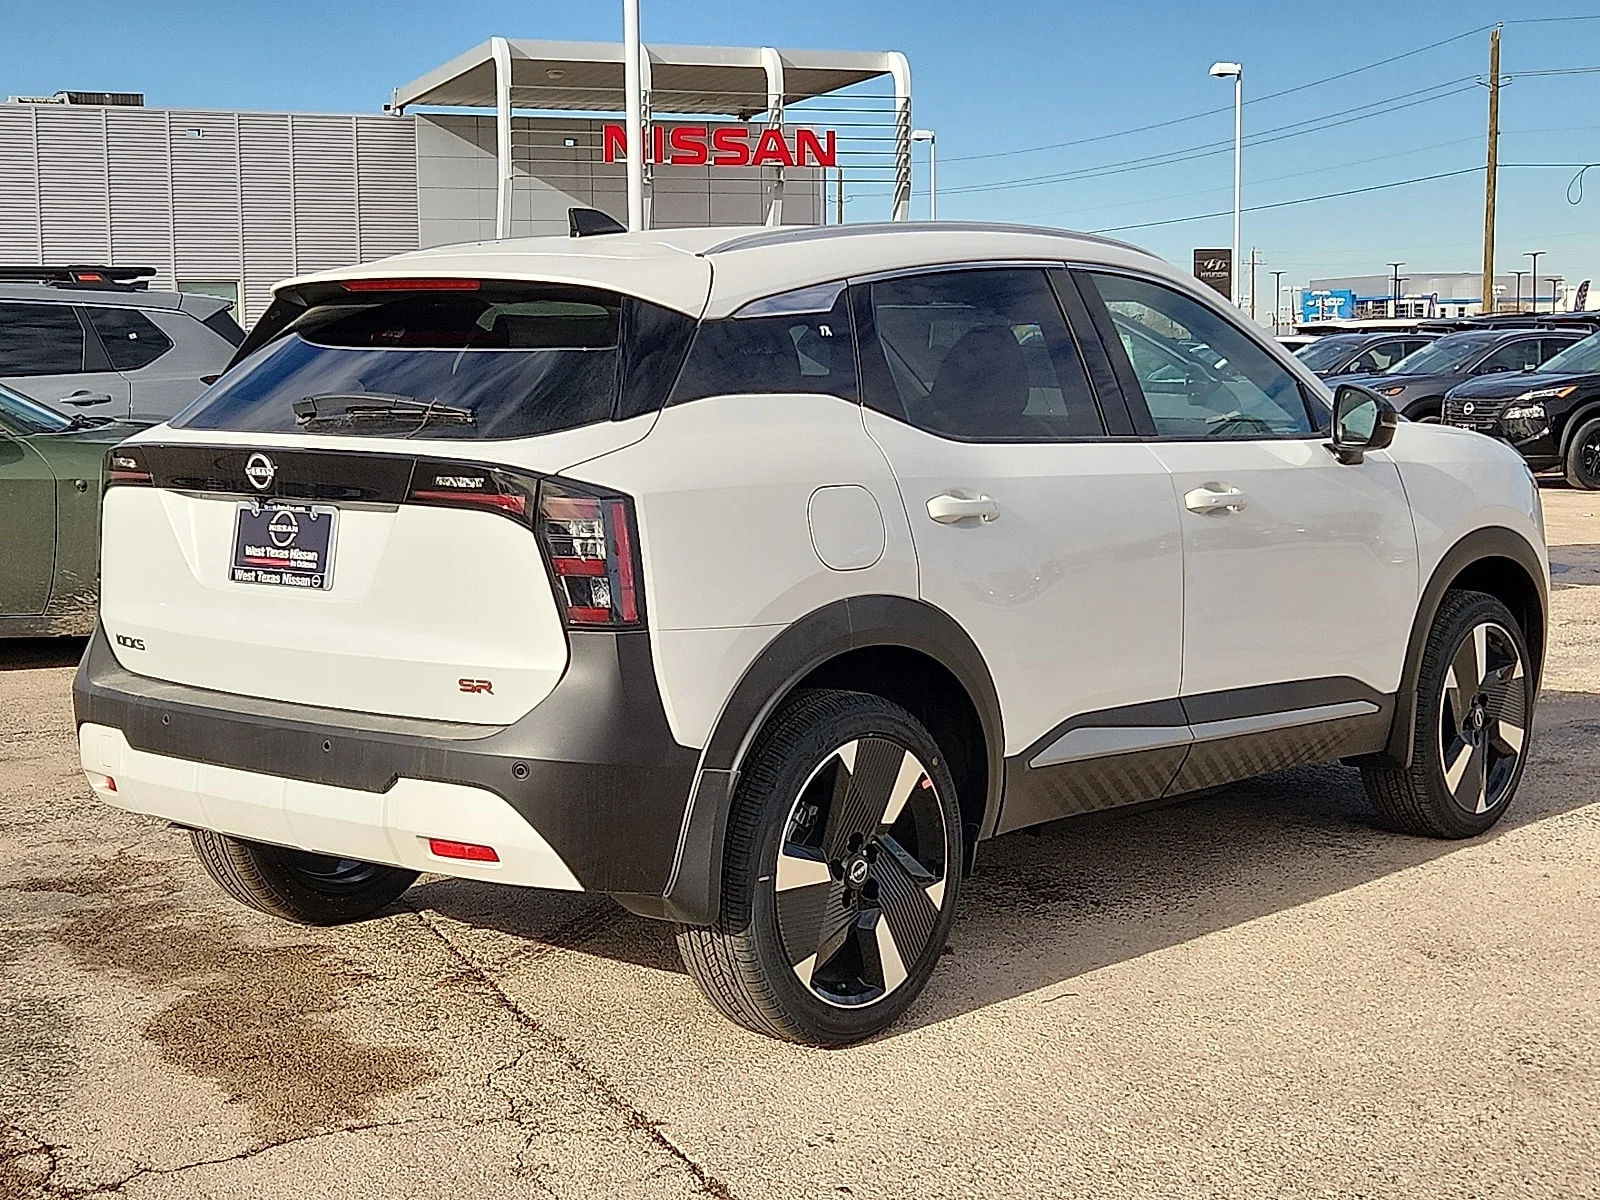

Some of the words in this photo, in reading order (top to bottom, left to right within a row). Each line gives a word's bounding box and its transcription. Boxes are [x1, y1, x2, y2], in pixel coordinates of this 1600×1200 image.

[603, 124, 837, 167] NISSAN
[245, 545, 265, 557] West
[266, 546, 289, 558] Texas
[290, 548, 318, 561] Nissan
[235, 569, 256, 581] West
[257, 570, 281, 583] Texas
[282, 573, 311, 586] Nissan
[459, 679, 494, 695] SR
